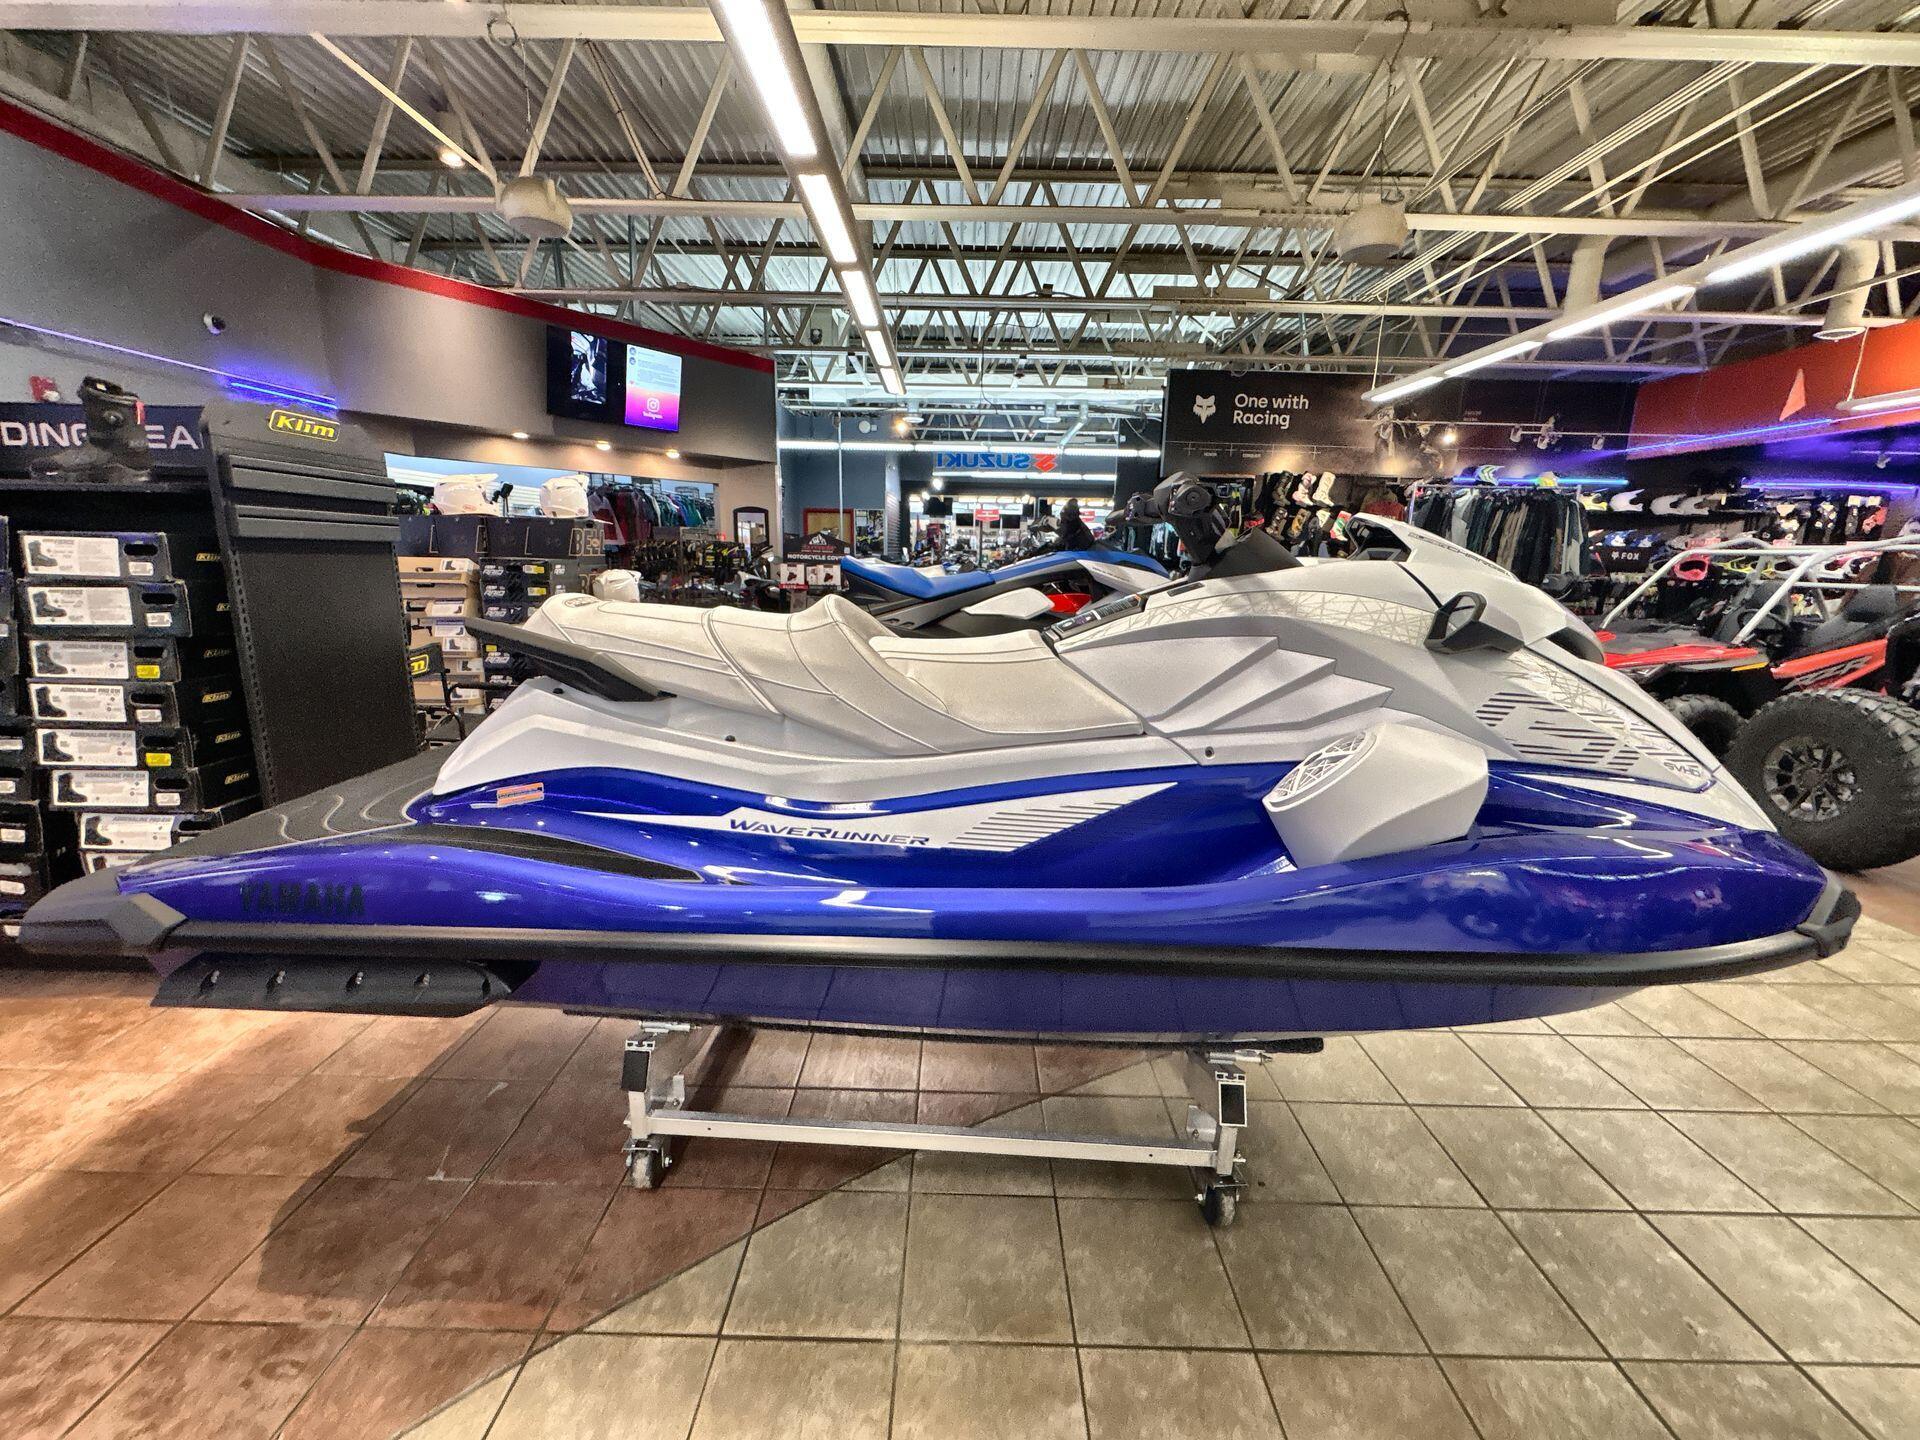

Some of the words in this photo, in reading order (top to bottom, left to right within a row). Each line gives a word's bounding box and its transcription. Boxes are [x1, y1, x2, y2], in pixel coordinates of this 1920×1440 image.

[1235, 393, 1268, 408] One
[1272, 394, 1309, 410] with
[276, 415, 335, 438] Klim
[1233, 410, 1290, 430] Racing
[144, 425, 204, 449] EA
[787, 553, 826, 561] MOTORCYCLE
[1620, 552, 1640, 560] FOX
[730, 819, 930, 846] WAVERUNNER
[241, 880, 365, 915] YAMAHA
